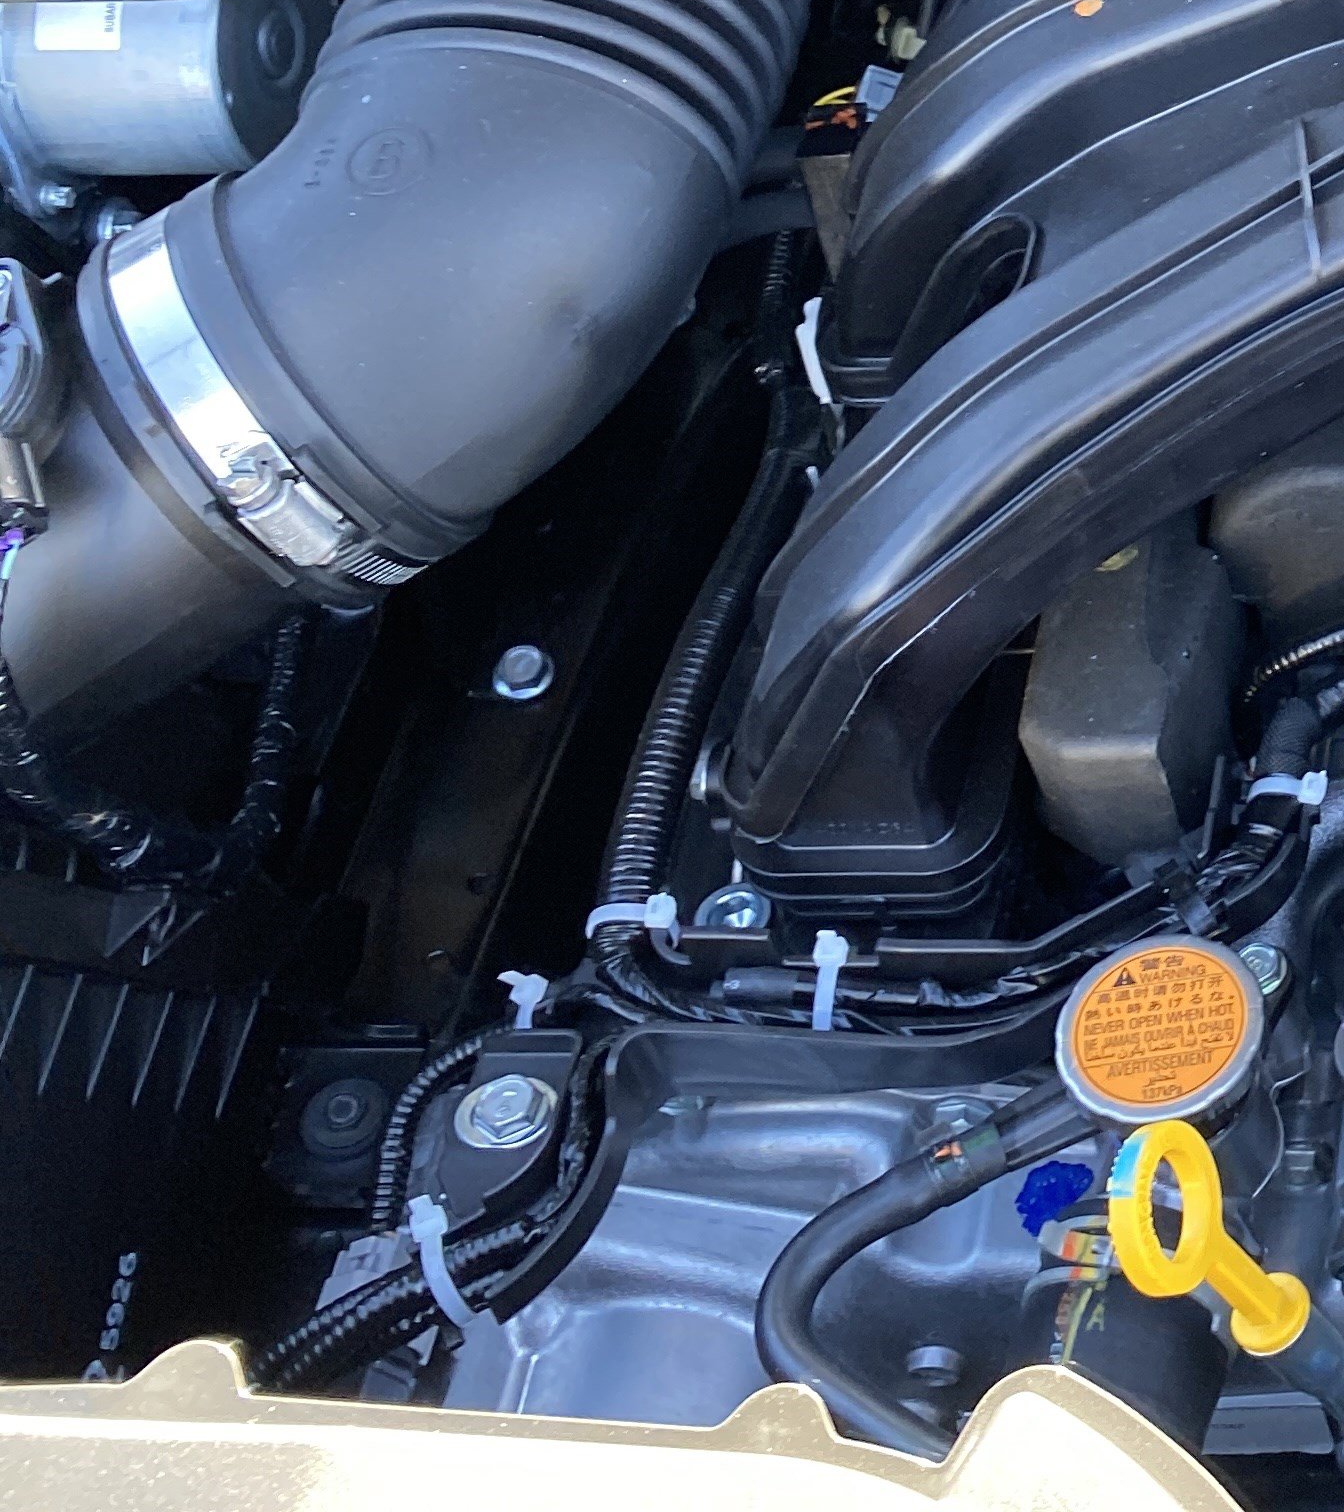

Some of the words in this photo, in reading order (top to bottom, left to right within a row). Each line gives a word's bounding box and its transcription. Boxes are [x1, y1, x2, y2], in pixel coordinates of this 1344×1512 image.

[1139, 963, 1206, 983] WARNING
[1084, 1019, 1123, 1036] NEVER
[1129, 1013, 1162, 1029] OPEN
[1166, 1008, 1204, 1023] WHEN
[1107, 1050, 1213, 1078] AVERTISSEMENT
